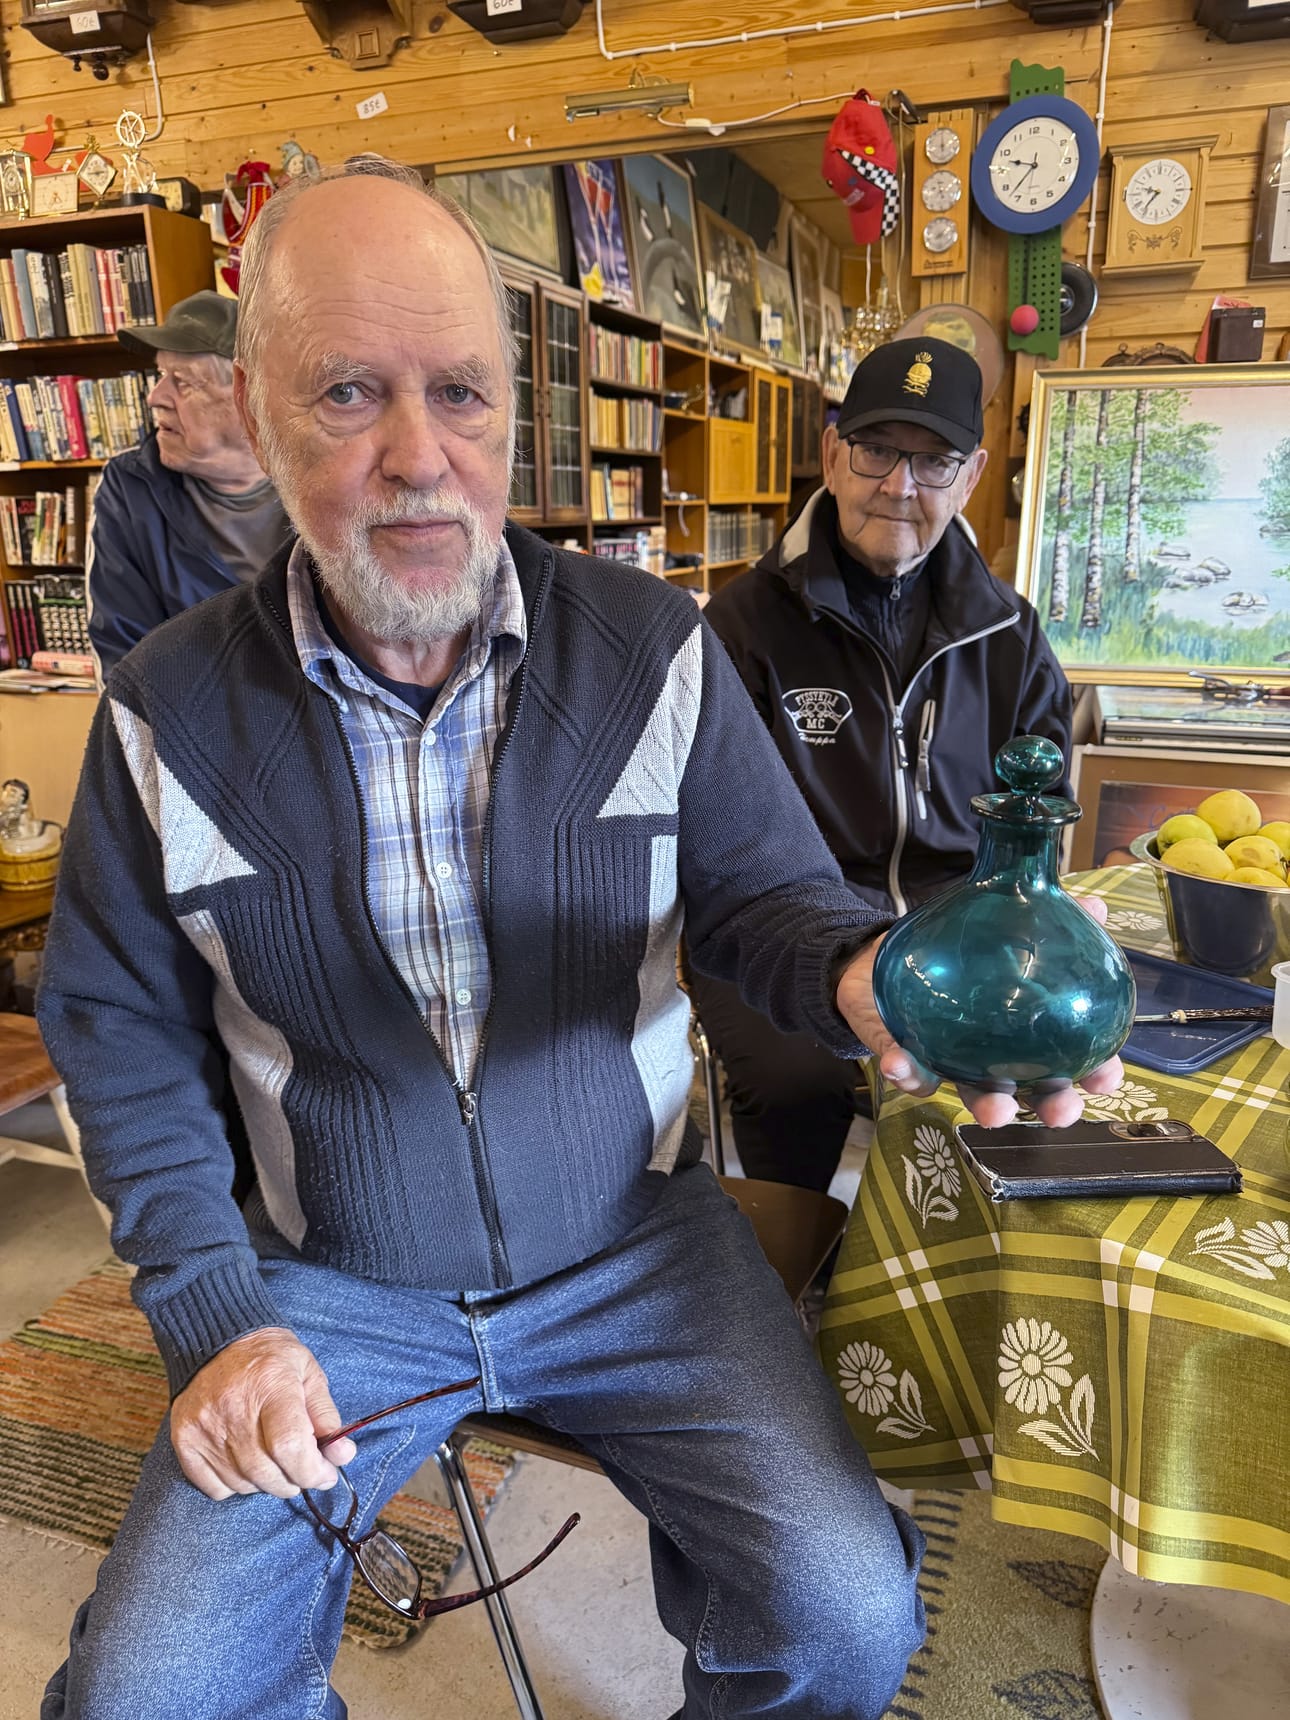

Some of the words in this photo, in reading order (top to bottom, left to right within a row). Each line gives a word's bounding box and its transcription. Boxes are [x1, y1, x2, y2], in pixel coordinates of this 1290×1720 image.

[1029, 126, 1040, 134] 12
[1014, 134, 1022, 142] 11
[1000, 149, 1011, 157] 10
[806, 718, 825, 729] MC
